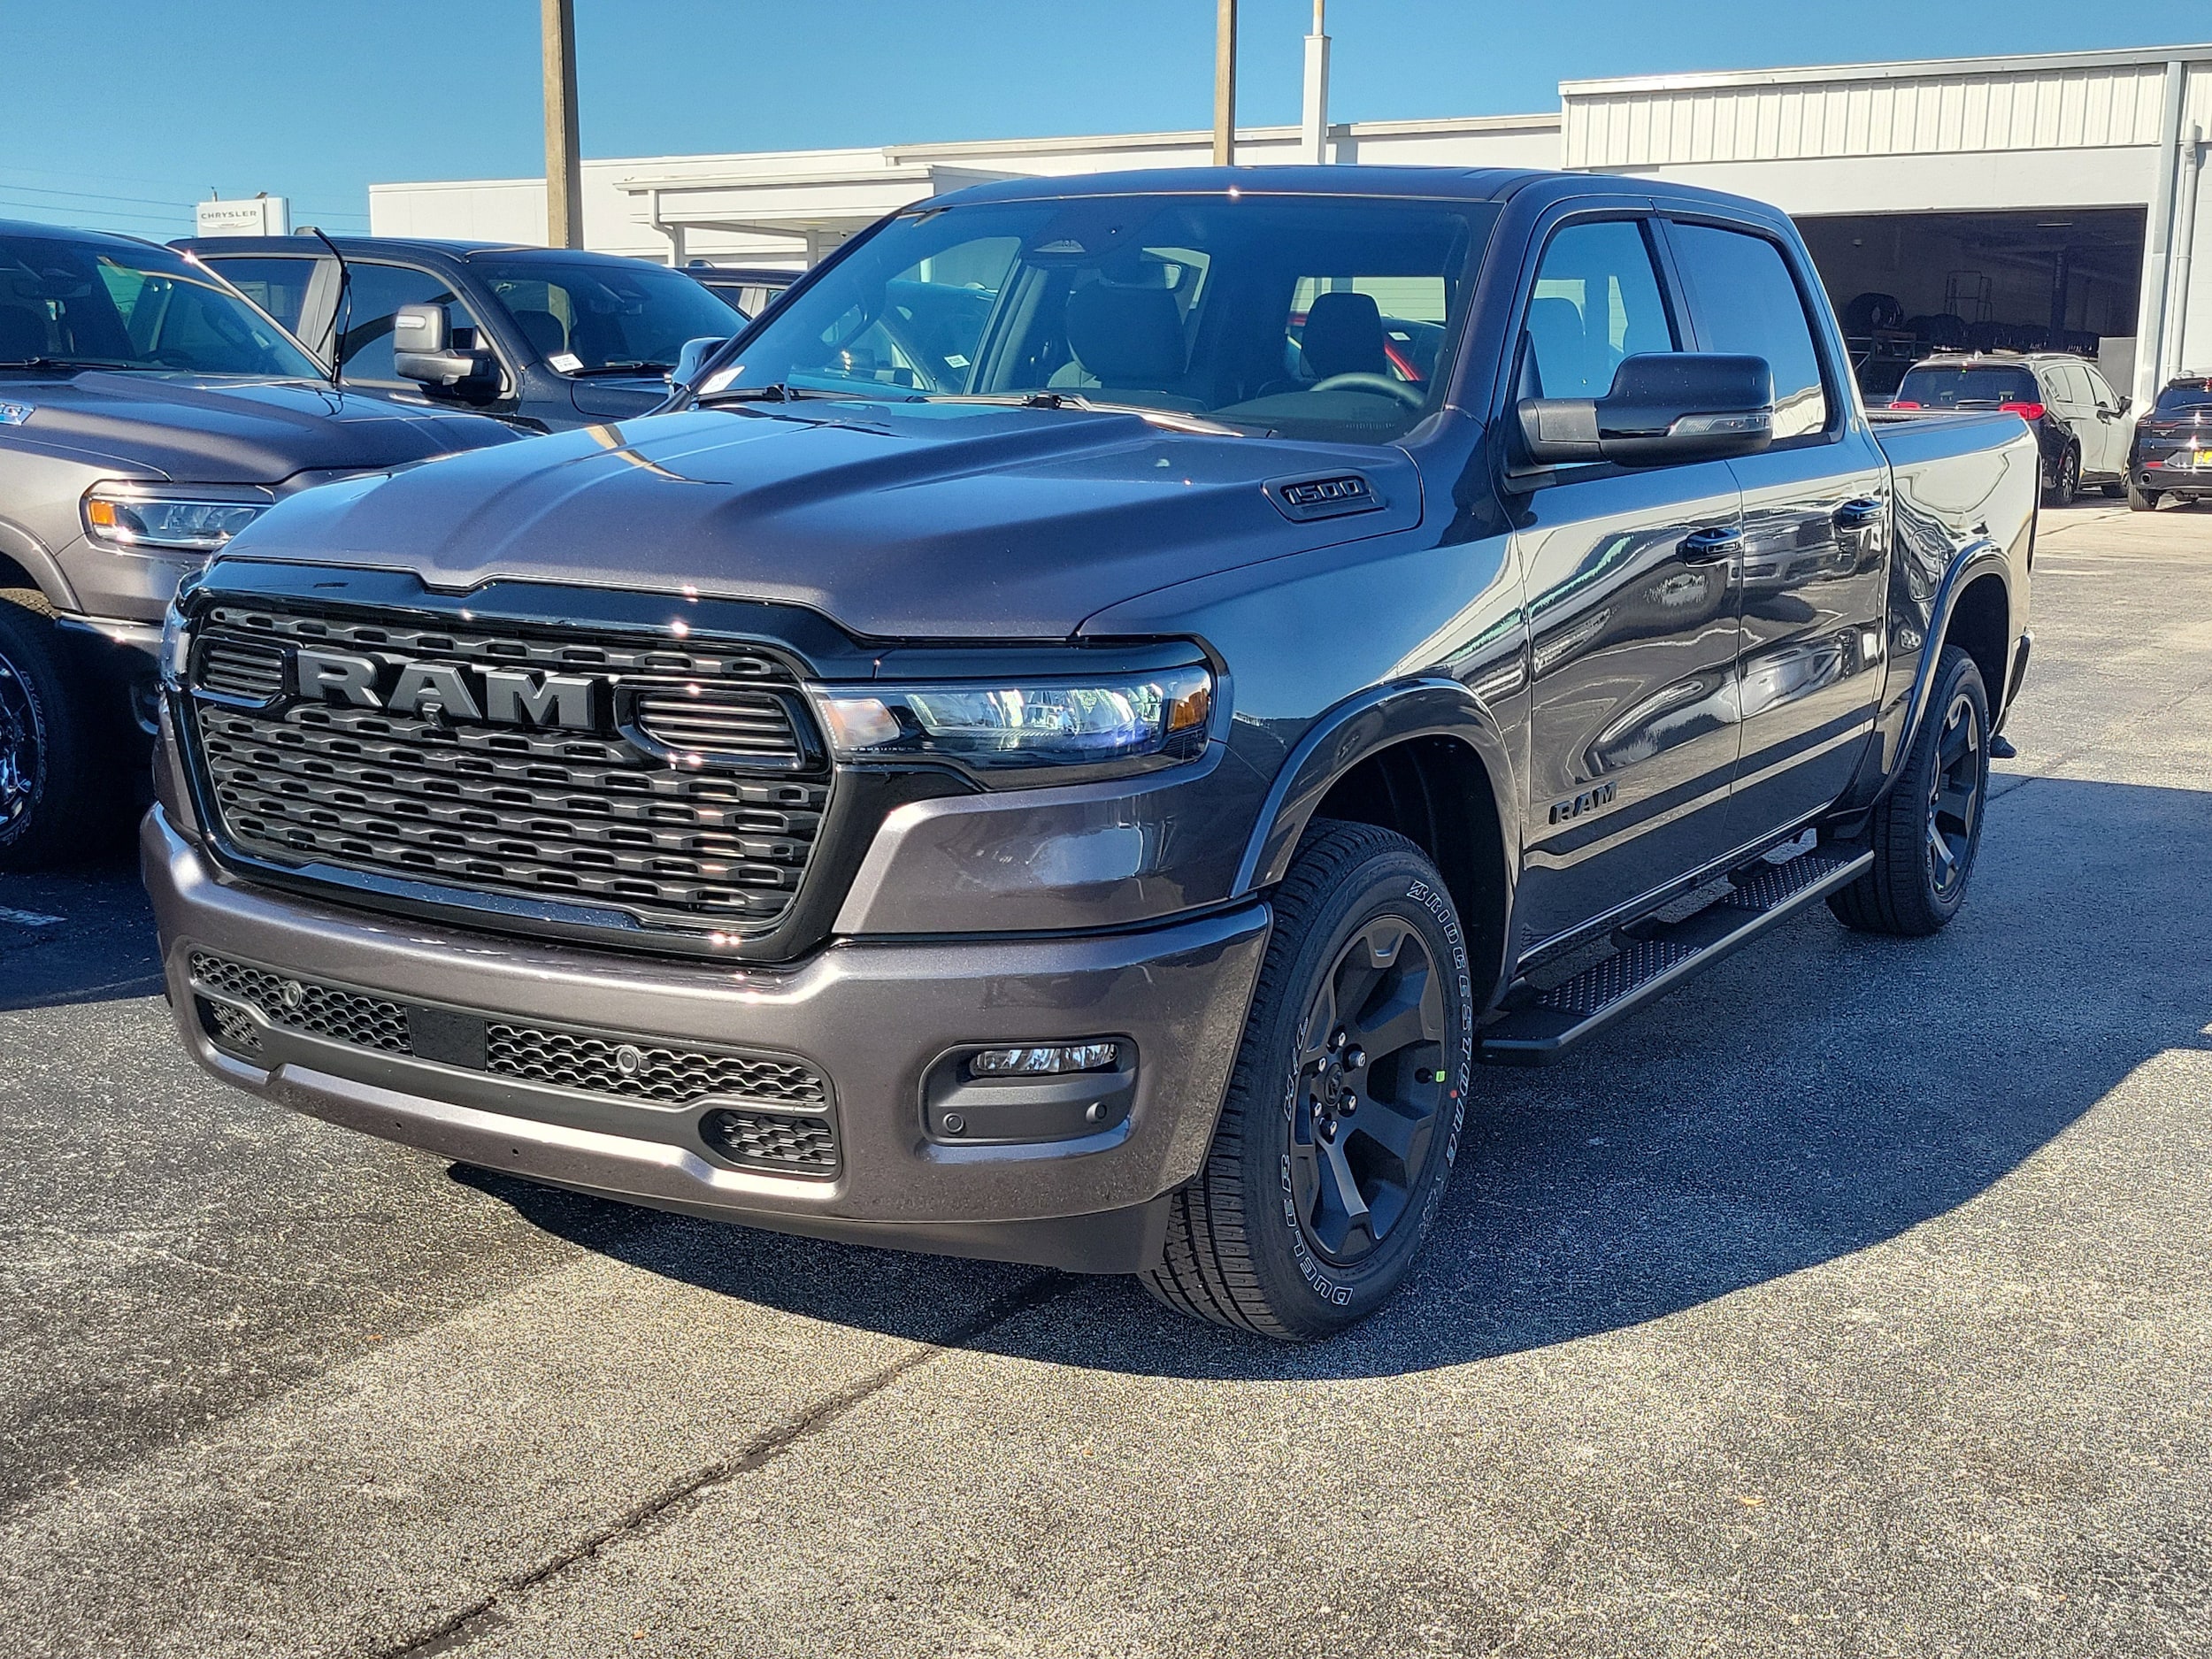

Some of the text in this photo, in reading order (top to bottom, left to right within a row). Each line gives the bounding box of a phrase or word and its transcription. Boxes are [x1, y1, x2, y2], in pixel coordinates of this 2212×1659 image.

[201, 210, 257, 220] CHRYSLER
[1286, 480, 1364, 505] 1500
[297, 649, 596, 731] RAM
[1548, 780, 1617, 825] RAM
[1406, 879, 1473, 1168] BRIDGESTONE
[1281, 1154, 1354, 1306] DUELER
